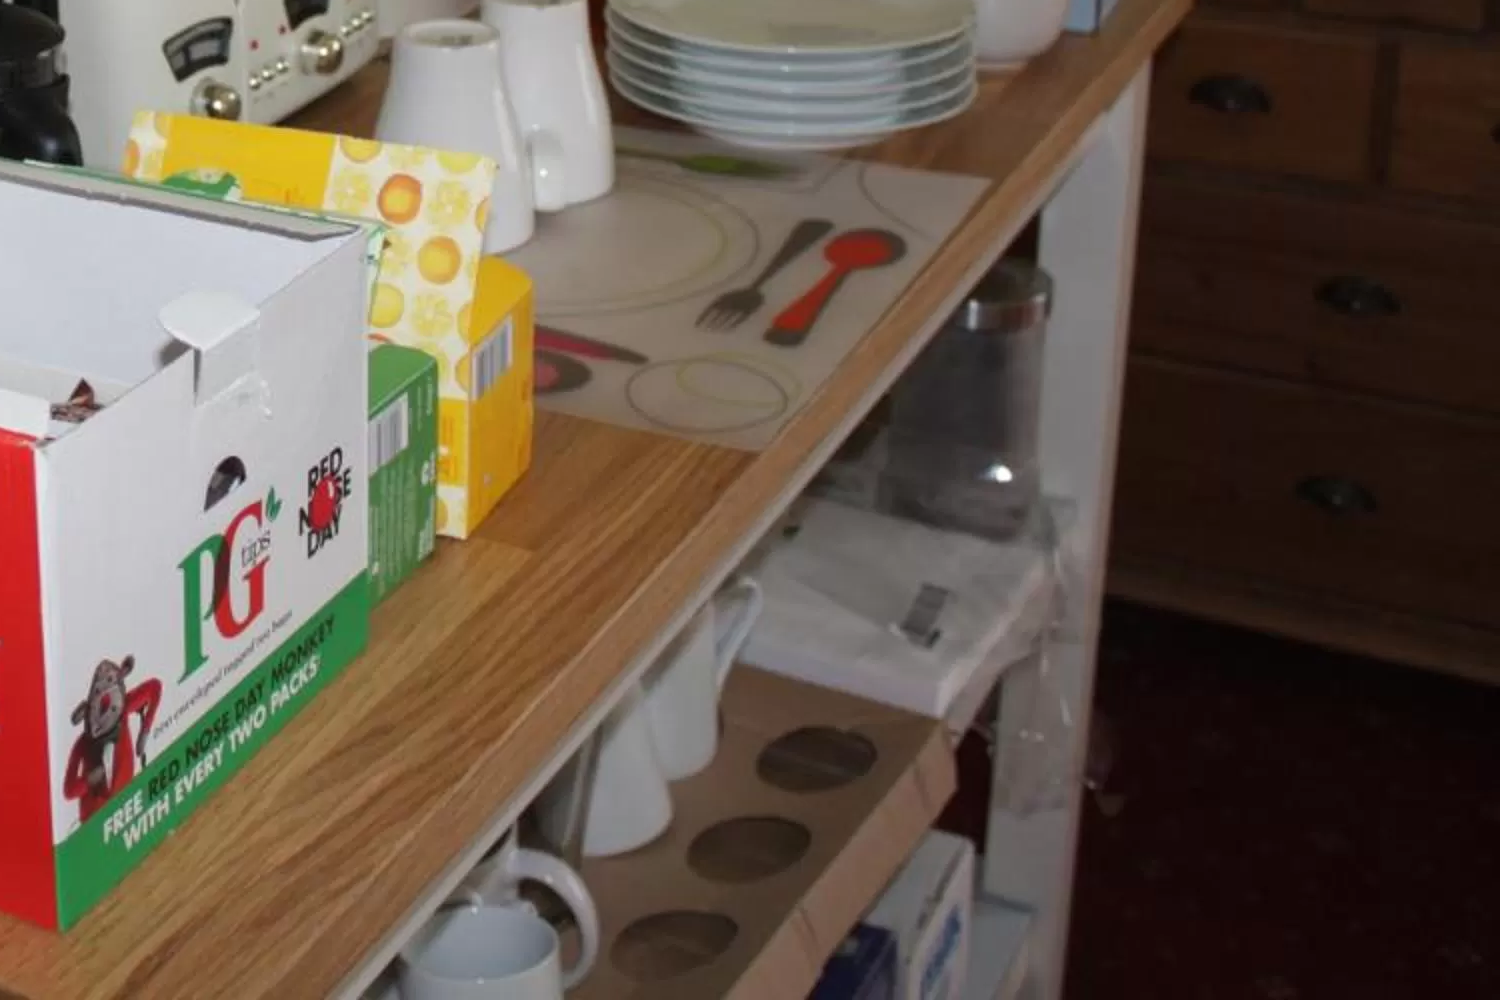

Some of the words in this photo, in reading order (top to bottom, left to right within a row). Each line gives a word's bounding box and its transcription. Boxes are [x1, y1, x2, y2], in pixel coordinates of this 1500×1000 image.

[308, 447, 343, 492] RED
[240, 530, 271, 568] tips
[307, 503, 342, 559] DAY
[177, 500, 270, 684] PG
[104, 789, 142, 844] FREE
[148, 760, 180, 800] RED
[185, 711, 229, 765] NOSE
[233, 677, 266, 721] DAY
[272, 614, 335, 688] MONKEY
[123, 792, 170, 851] WITH
[175, 741, 224, 804] EVERY
[228, 704, 267, 752] TWO
[270, 654, 321, 715] PACKS
